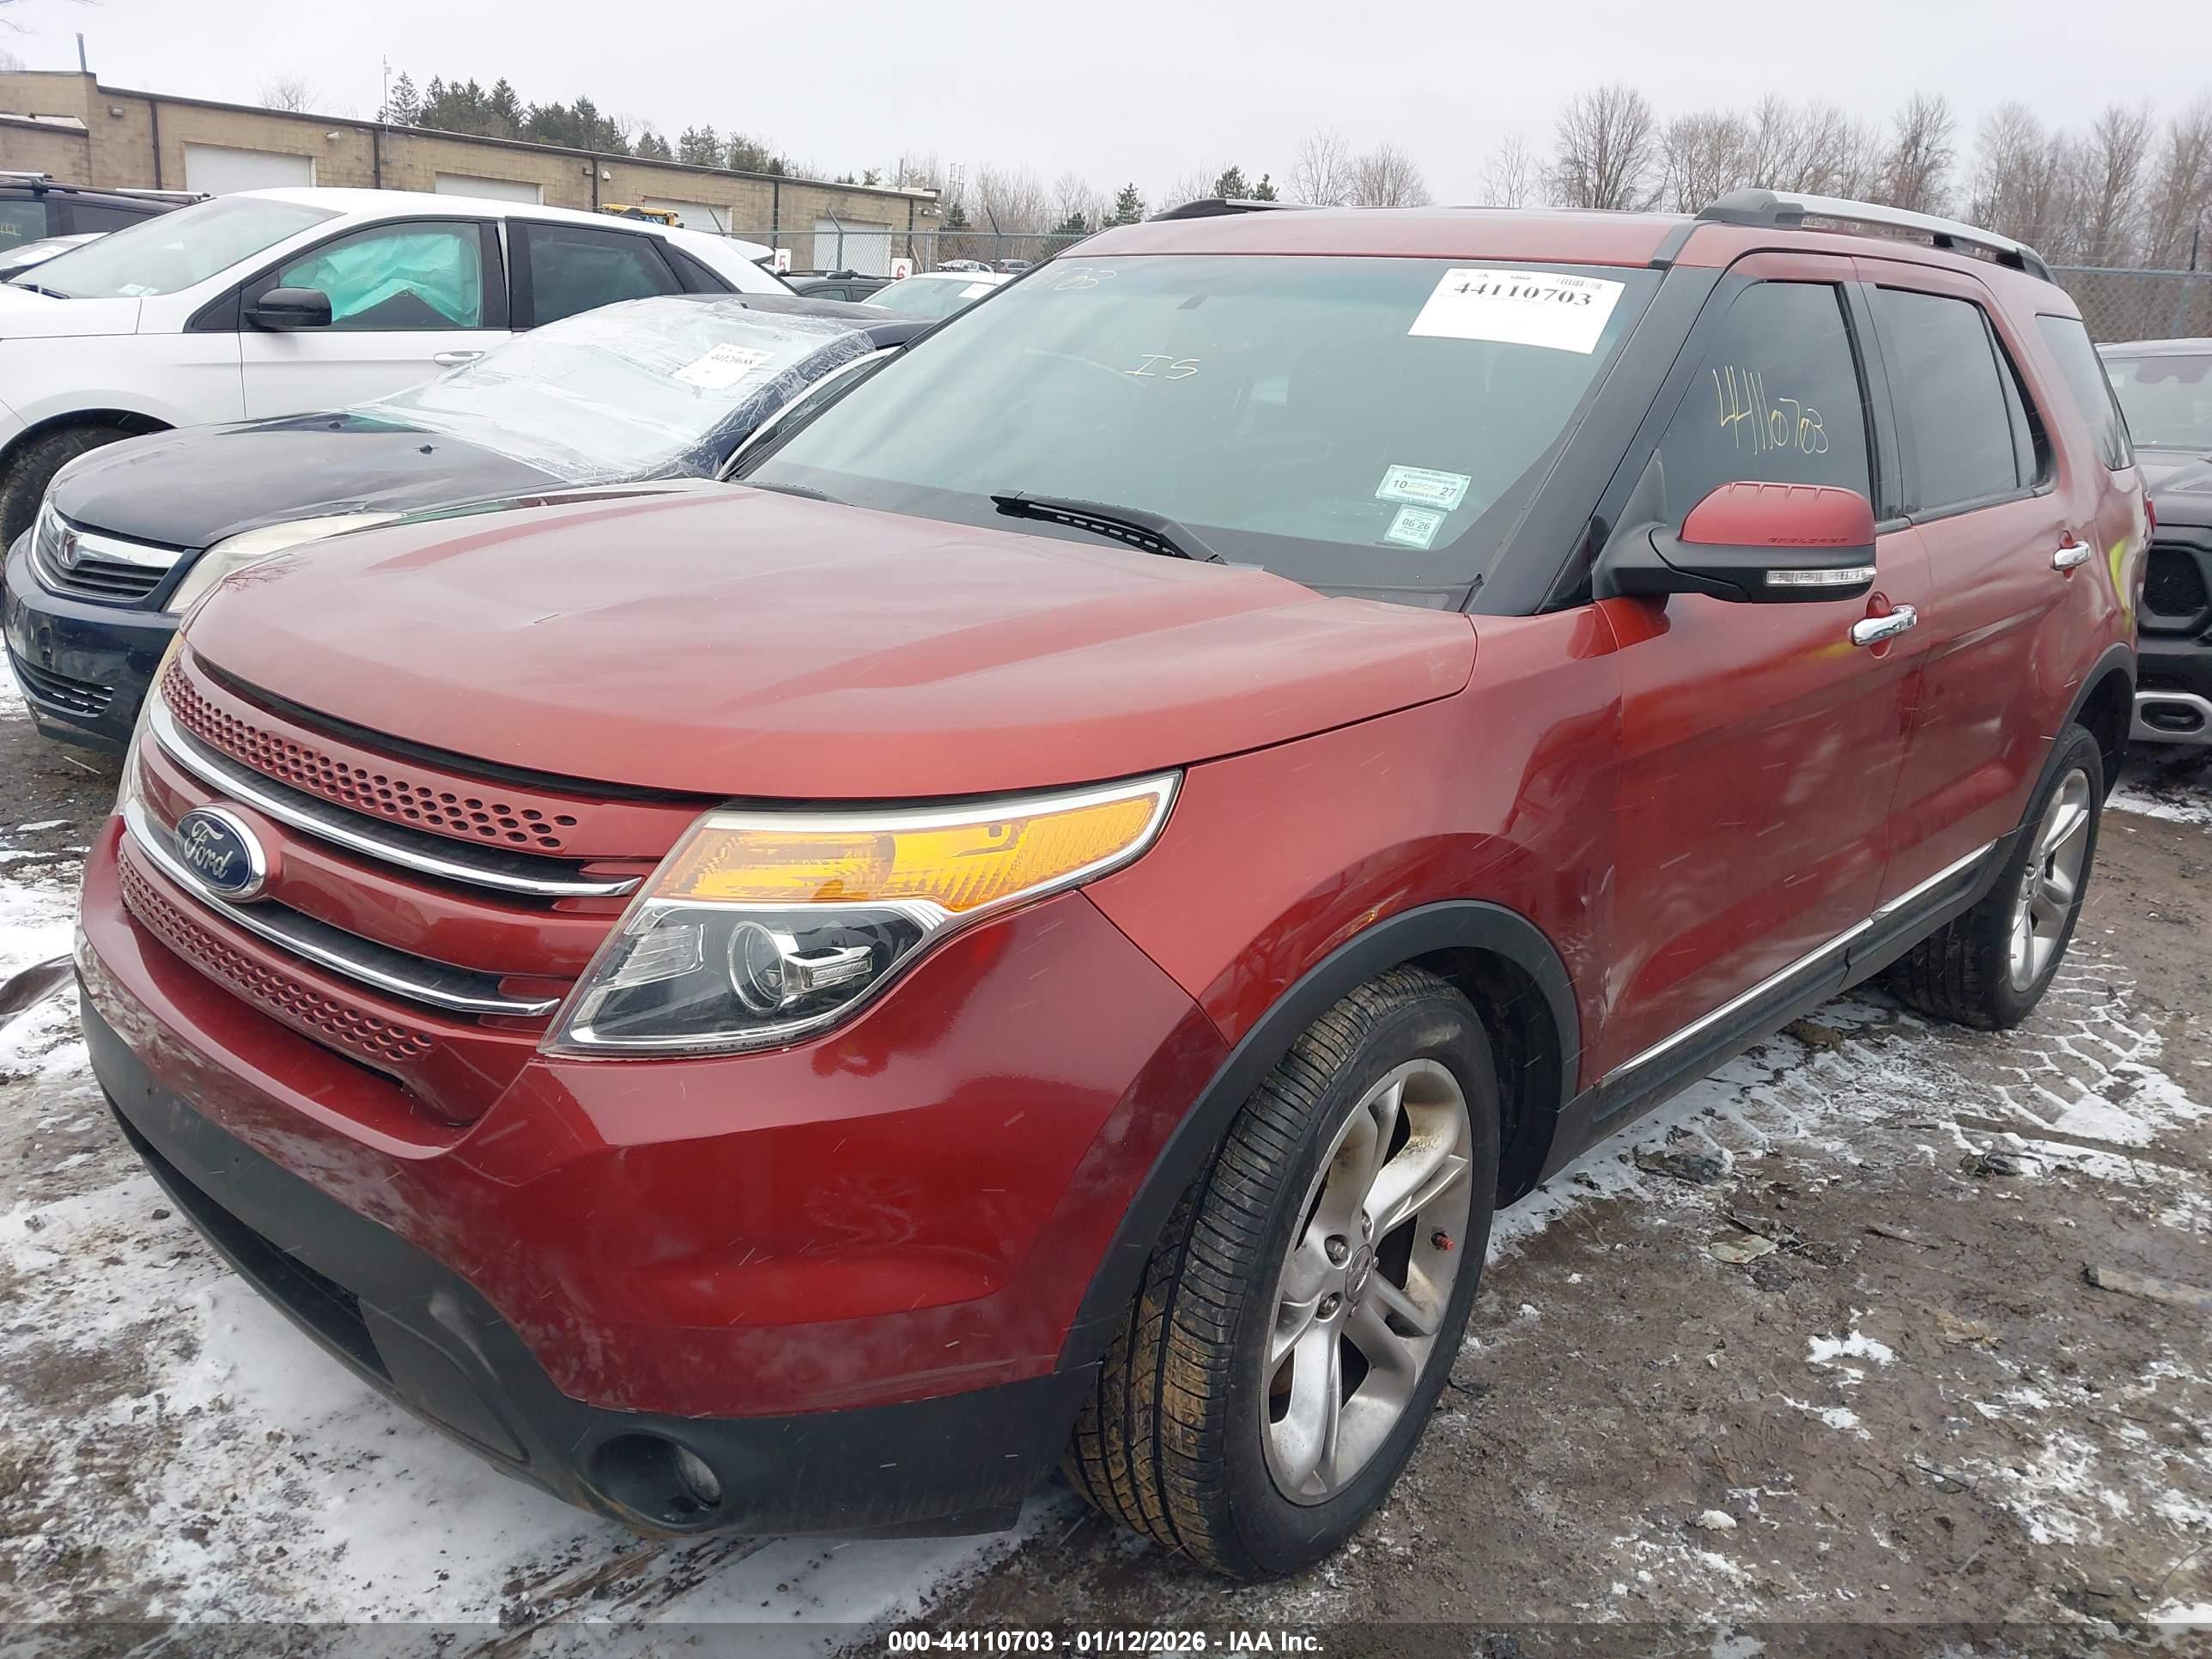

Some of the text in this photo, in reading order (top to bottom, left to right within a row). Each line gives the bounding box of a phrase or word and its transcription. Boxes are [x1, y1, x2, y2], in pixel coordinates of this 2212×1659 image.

[779, 255, 786, 270] 5
[896, 264, 907, 280] 6
[1453, 282, 1593, 306] 44110703
[1712, 365, 1829, 455] 44110703
[1393, 479, 1408, 489] 10
[1439, 487, 1457, 497] 27
[184, 820, 234, 879] Ford
